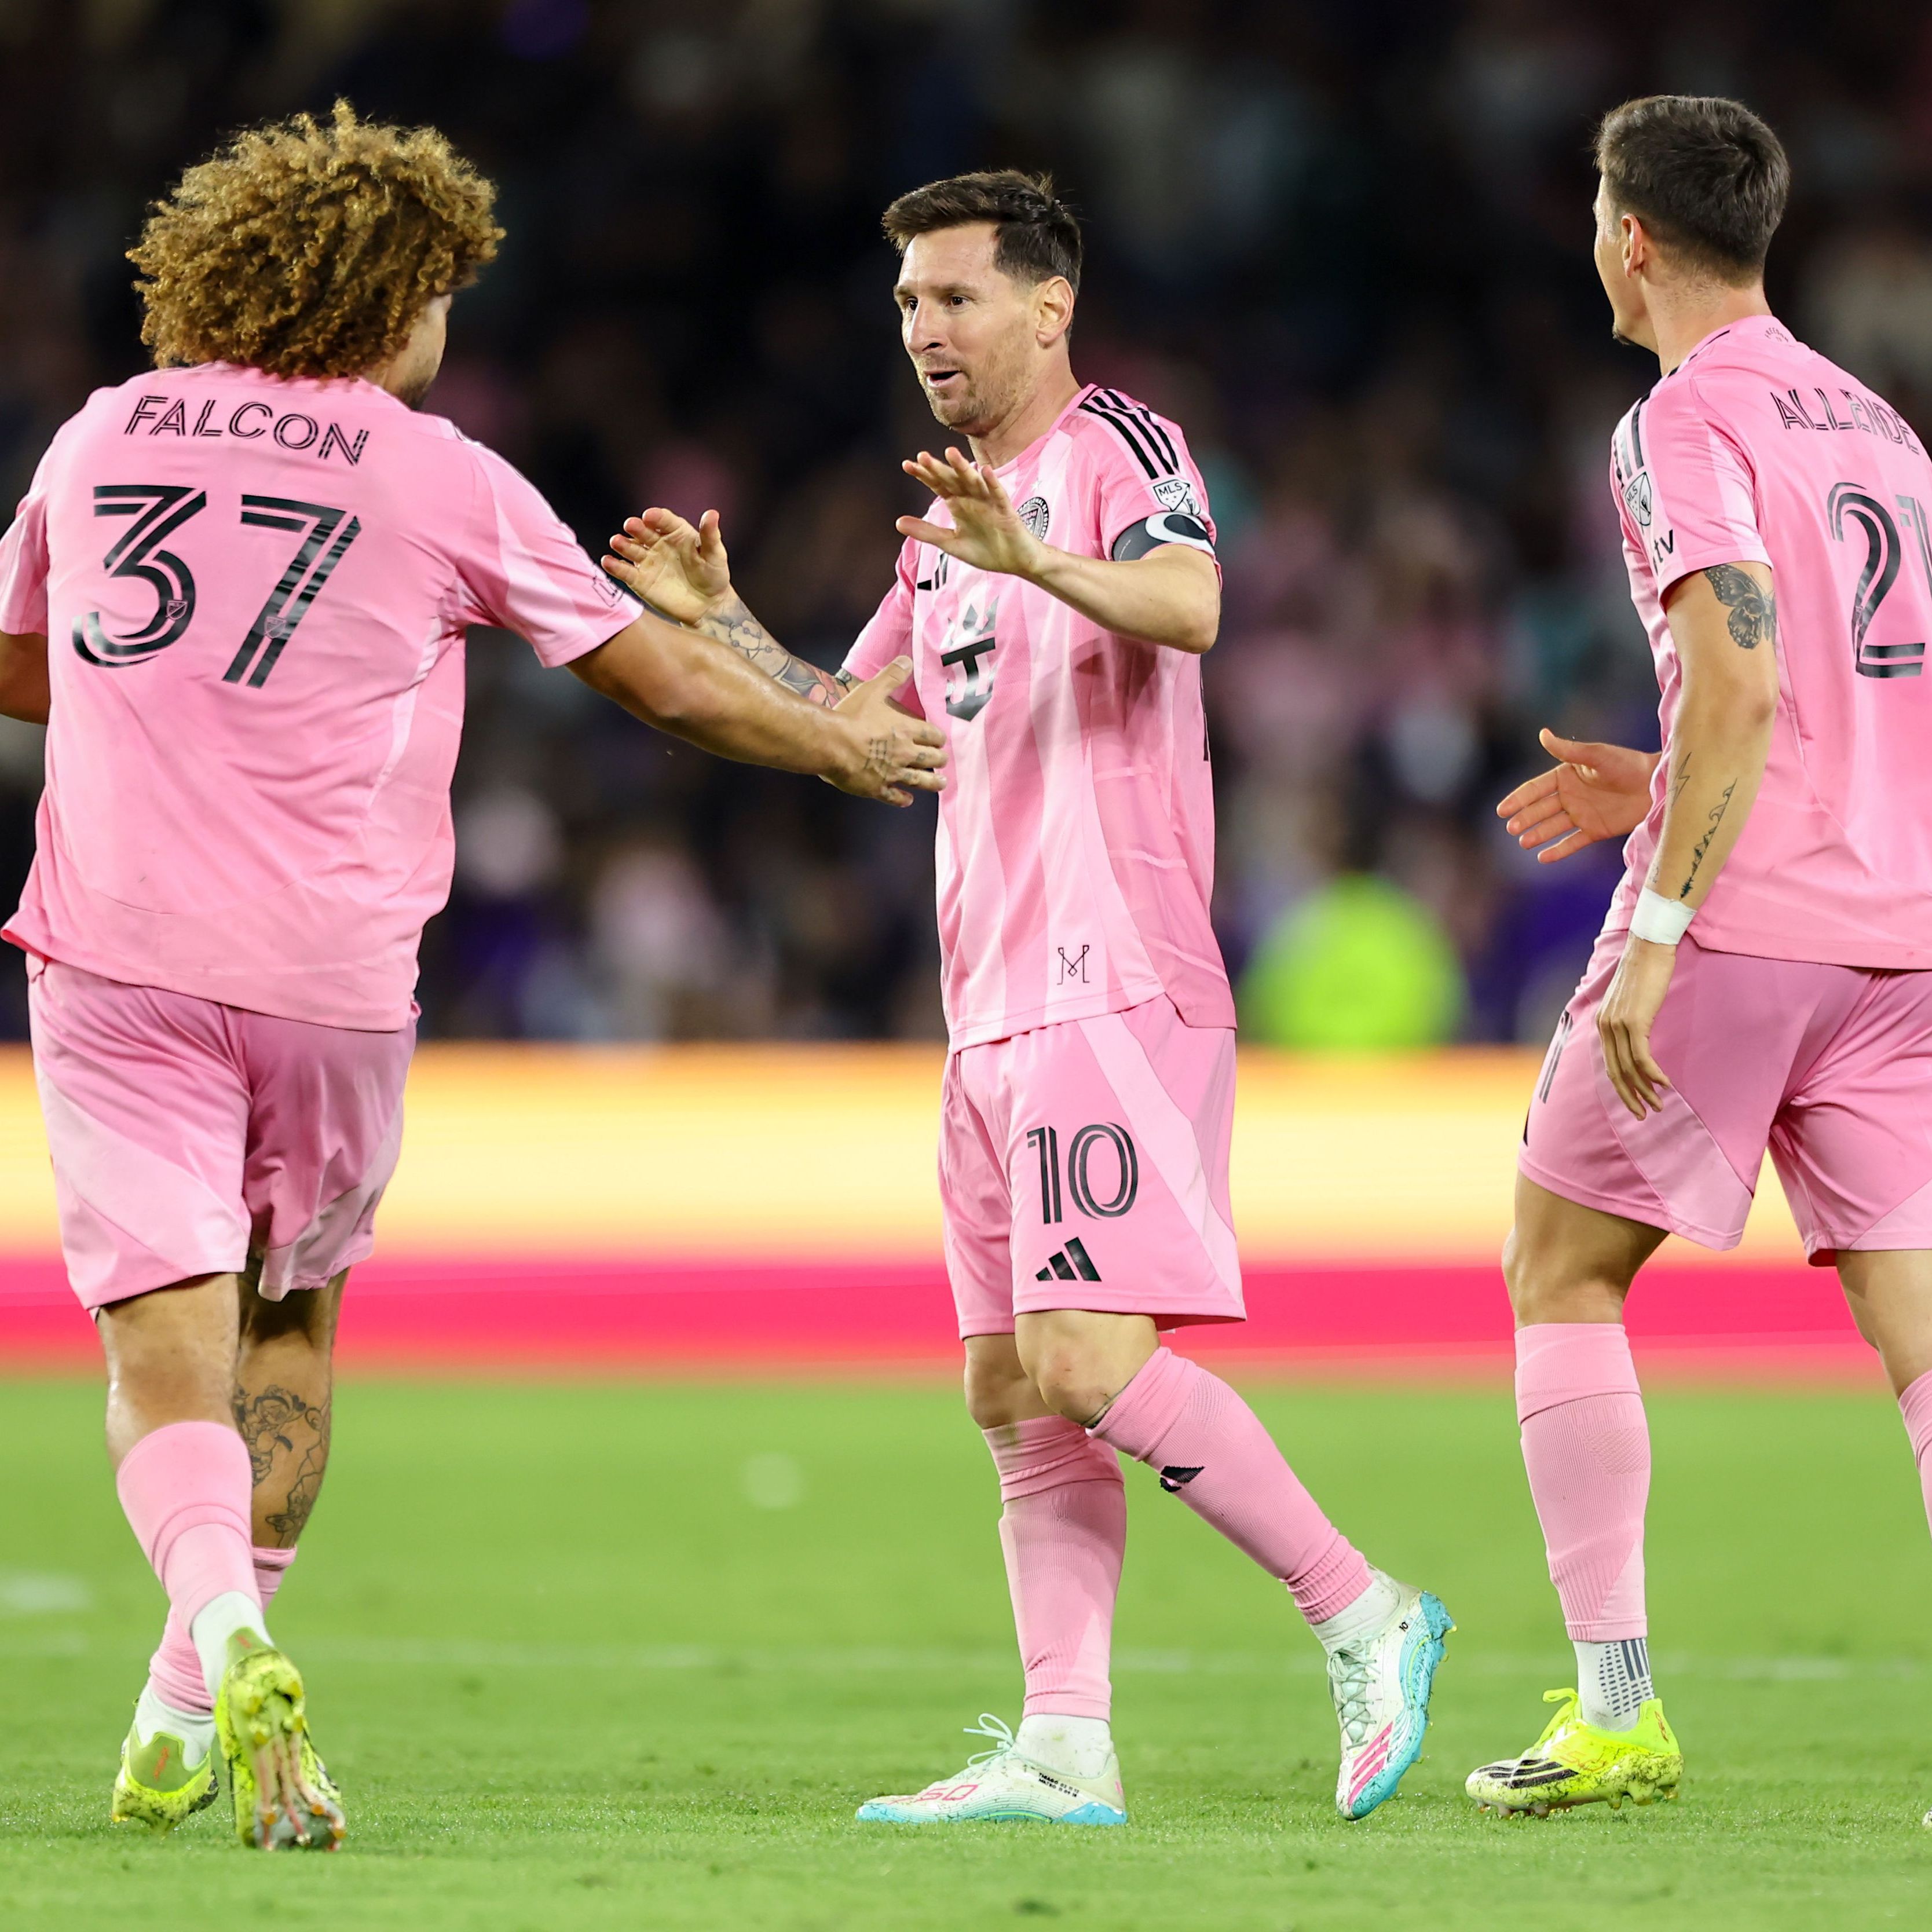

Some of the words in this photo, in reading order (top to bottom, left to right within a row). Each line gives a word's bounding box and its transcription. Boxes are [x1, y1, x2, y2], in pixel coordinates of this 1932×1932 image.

[124, 395, 369, 466] FALCON
[1770, 388, 1920, 455] ALLENDE
[1158, 482, 1183, 496] MLS
[1626, 485, 1638, 505] MLS
[71, 485, 361, 689] 37
[1828, 482, 1932, 678] 21
[1027, 1122, 1139, 1225] 10
[1399, 1622, 1408, 1632] 10
